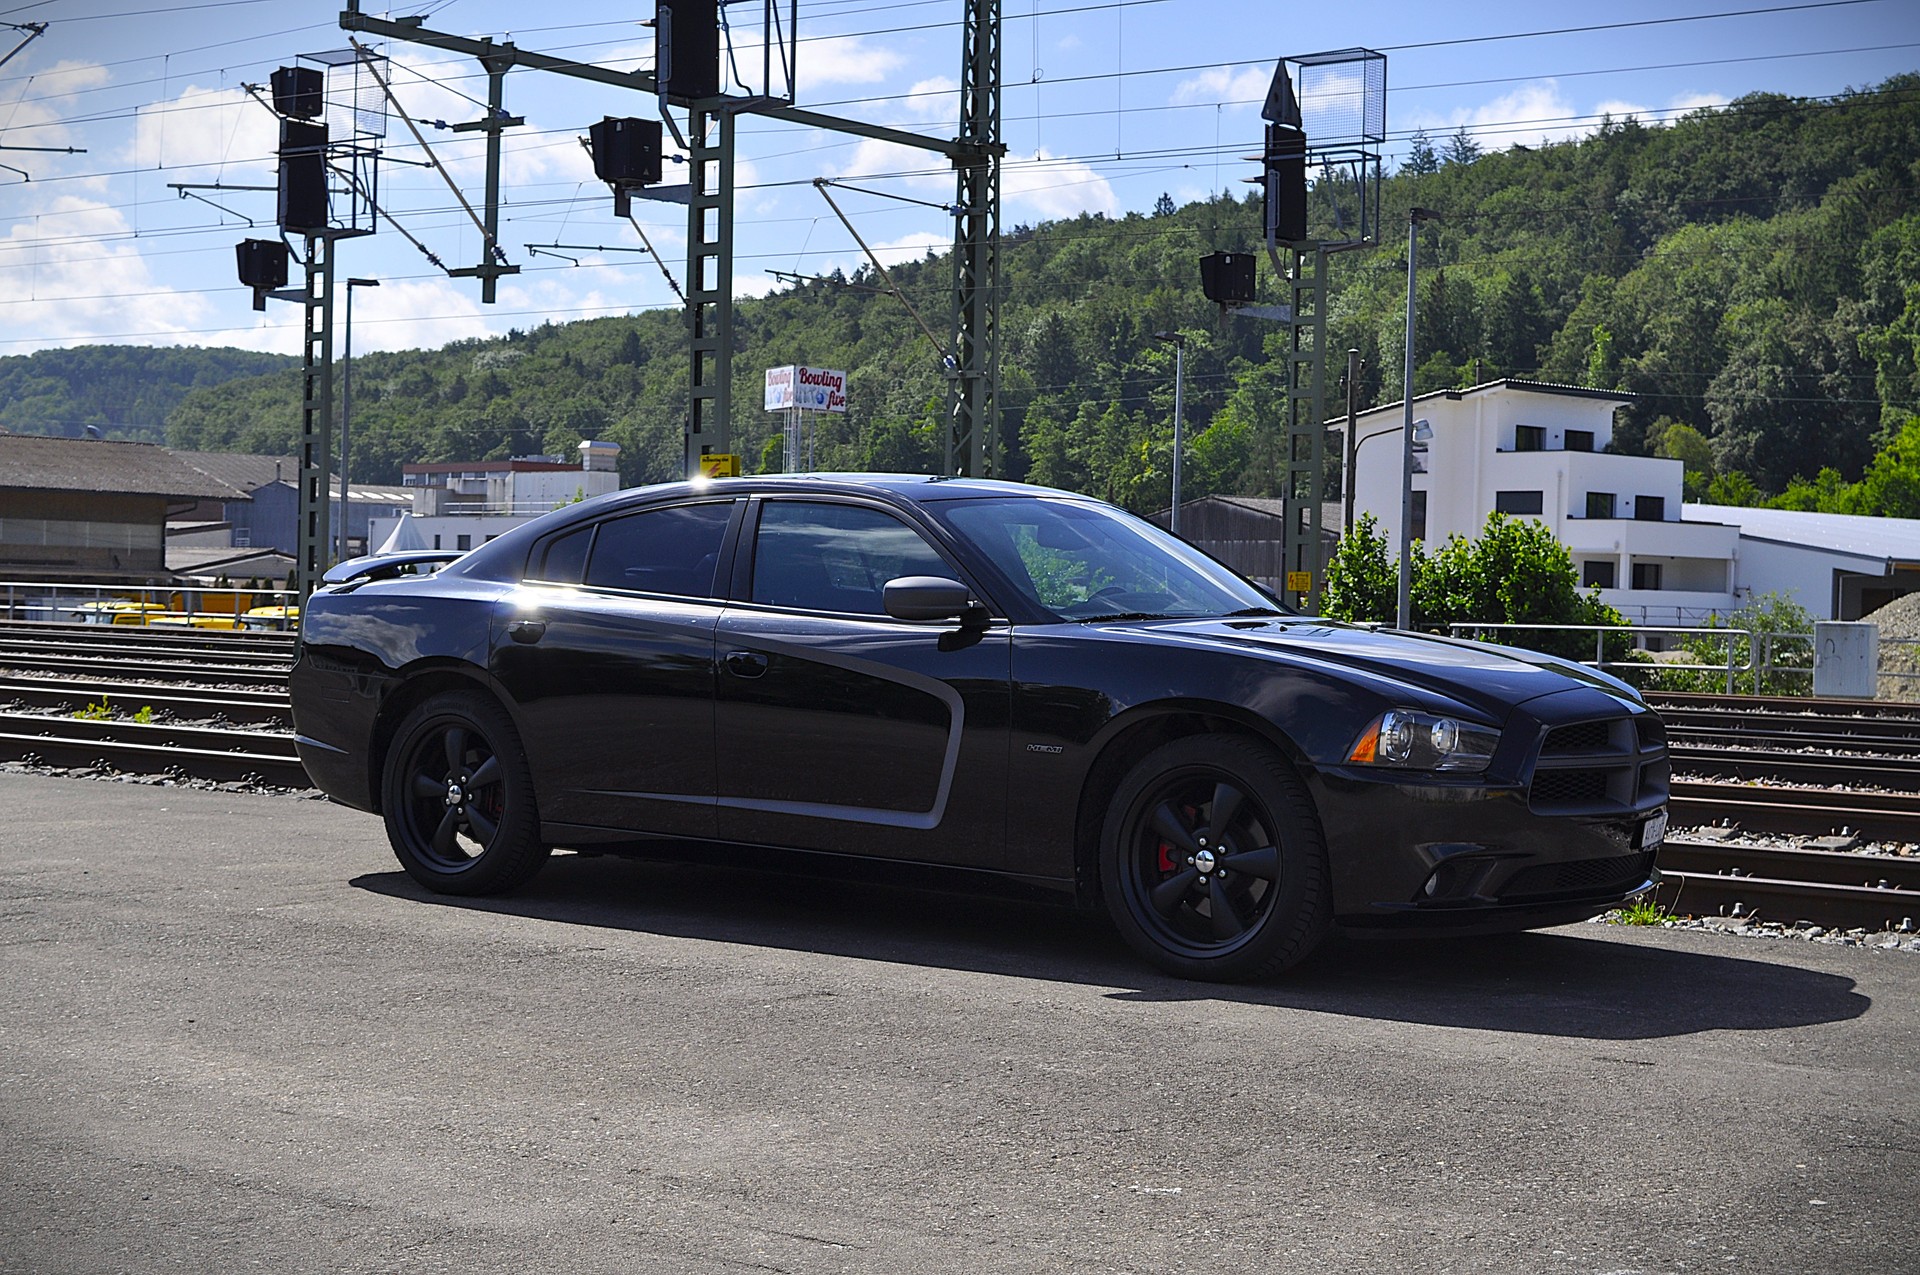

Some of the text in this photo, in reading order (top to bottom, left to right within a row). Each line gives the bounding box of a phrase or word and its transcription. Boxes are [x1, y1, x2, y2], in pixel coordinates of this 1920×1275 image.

[767, 370, 791, 388] Bowling
[799, 367, 842, 393] Bowling
[826, 390, 846, 410] five
[1026, 744, 1062, 753] HEMI
